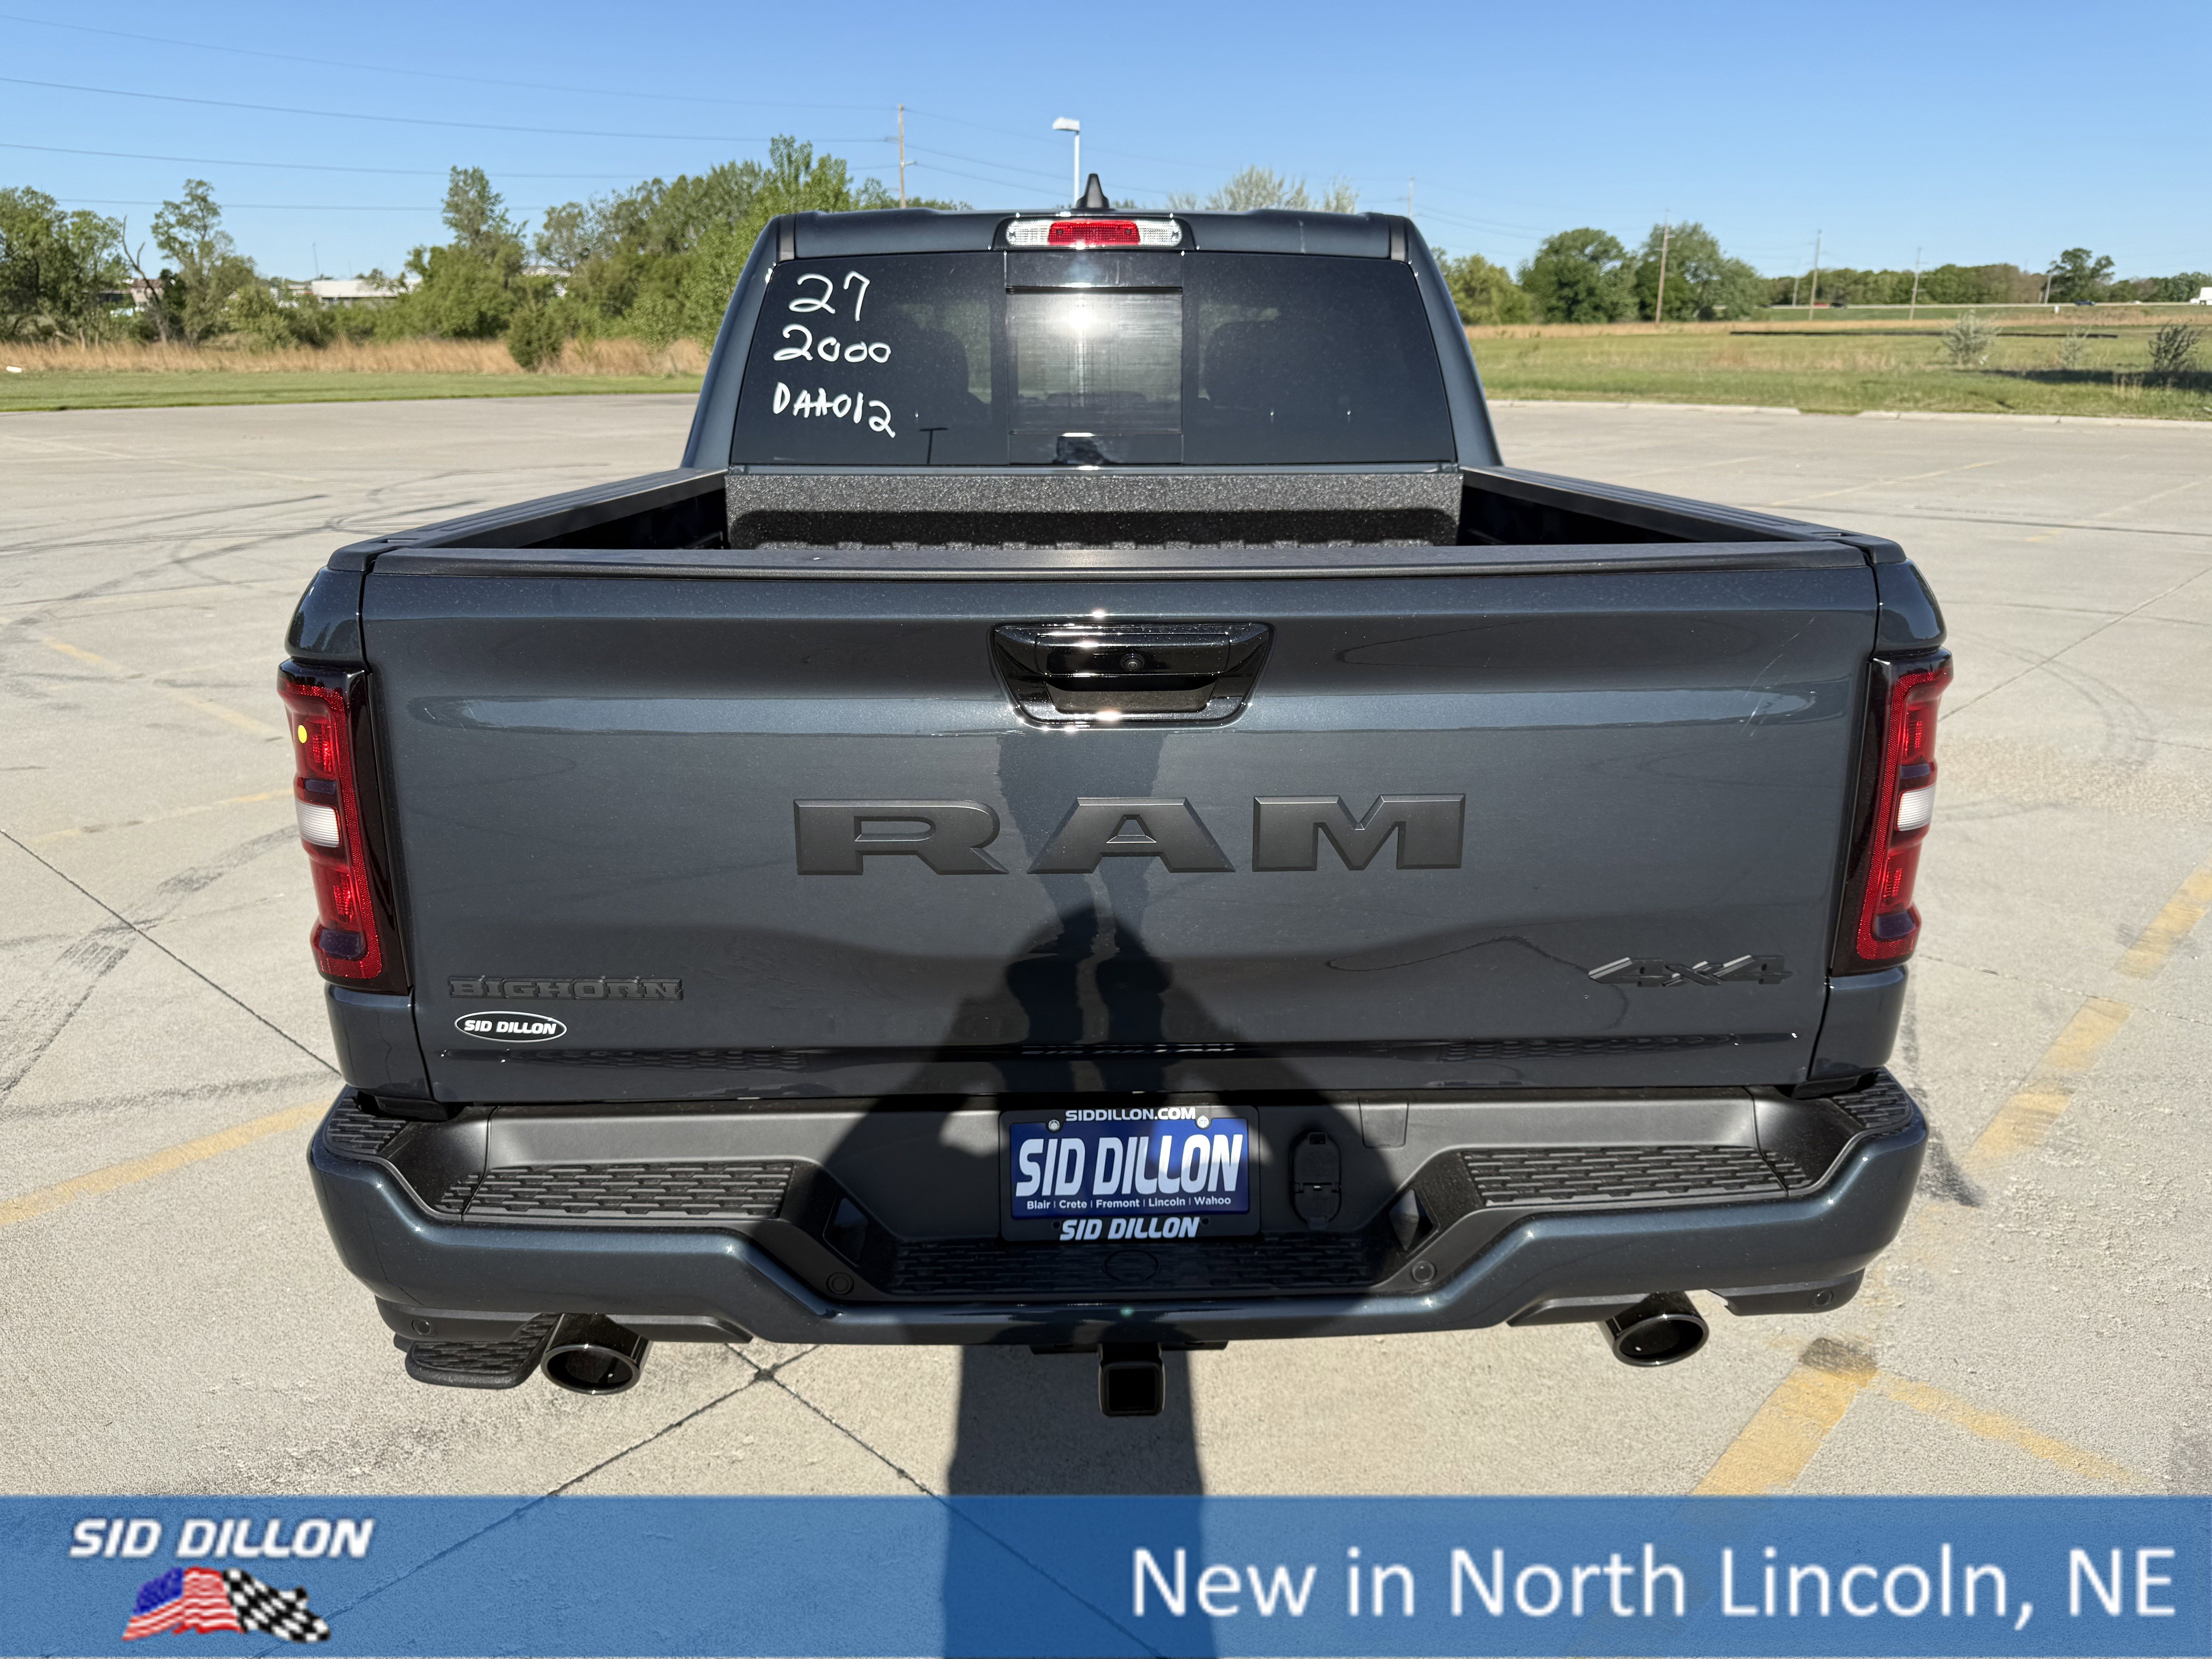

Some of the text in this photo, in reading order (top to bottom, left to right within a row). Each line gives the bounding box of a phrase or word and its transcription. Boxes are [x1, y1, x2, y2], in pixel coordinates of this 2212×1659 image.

[788, 271, 870, 321] 27
[773, 324, 891, 362] 2000
[794, 794, 1466, 876] RAM
[464, 1020, 556, 1035] SID DILLON
[1065, 1107, 1195, 1121] SIDDILLON.COM
[1015, 1134, 1243, 1197] SID DILLON
[1027, 1196, 1231, 1210] Blair Crete Fremont Lincoln Wahoo
[1060, 1217, 1200, 1241] SID DILLON
